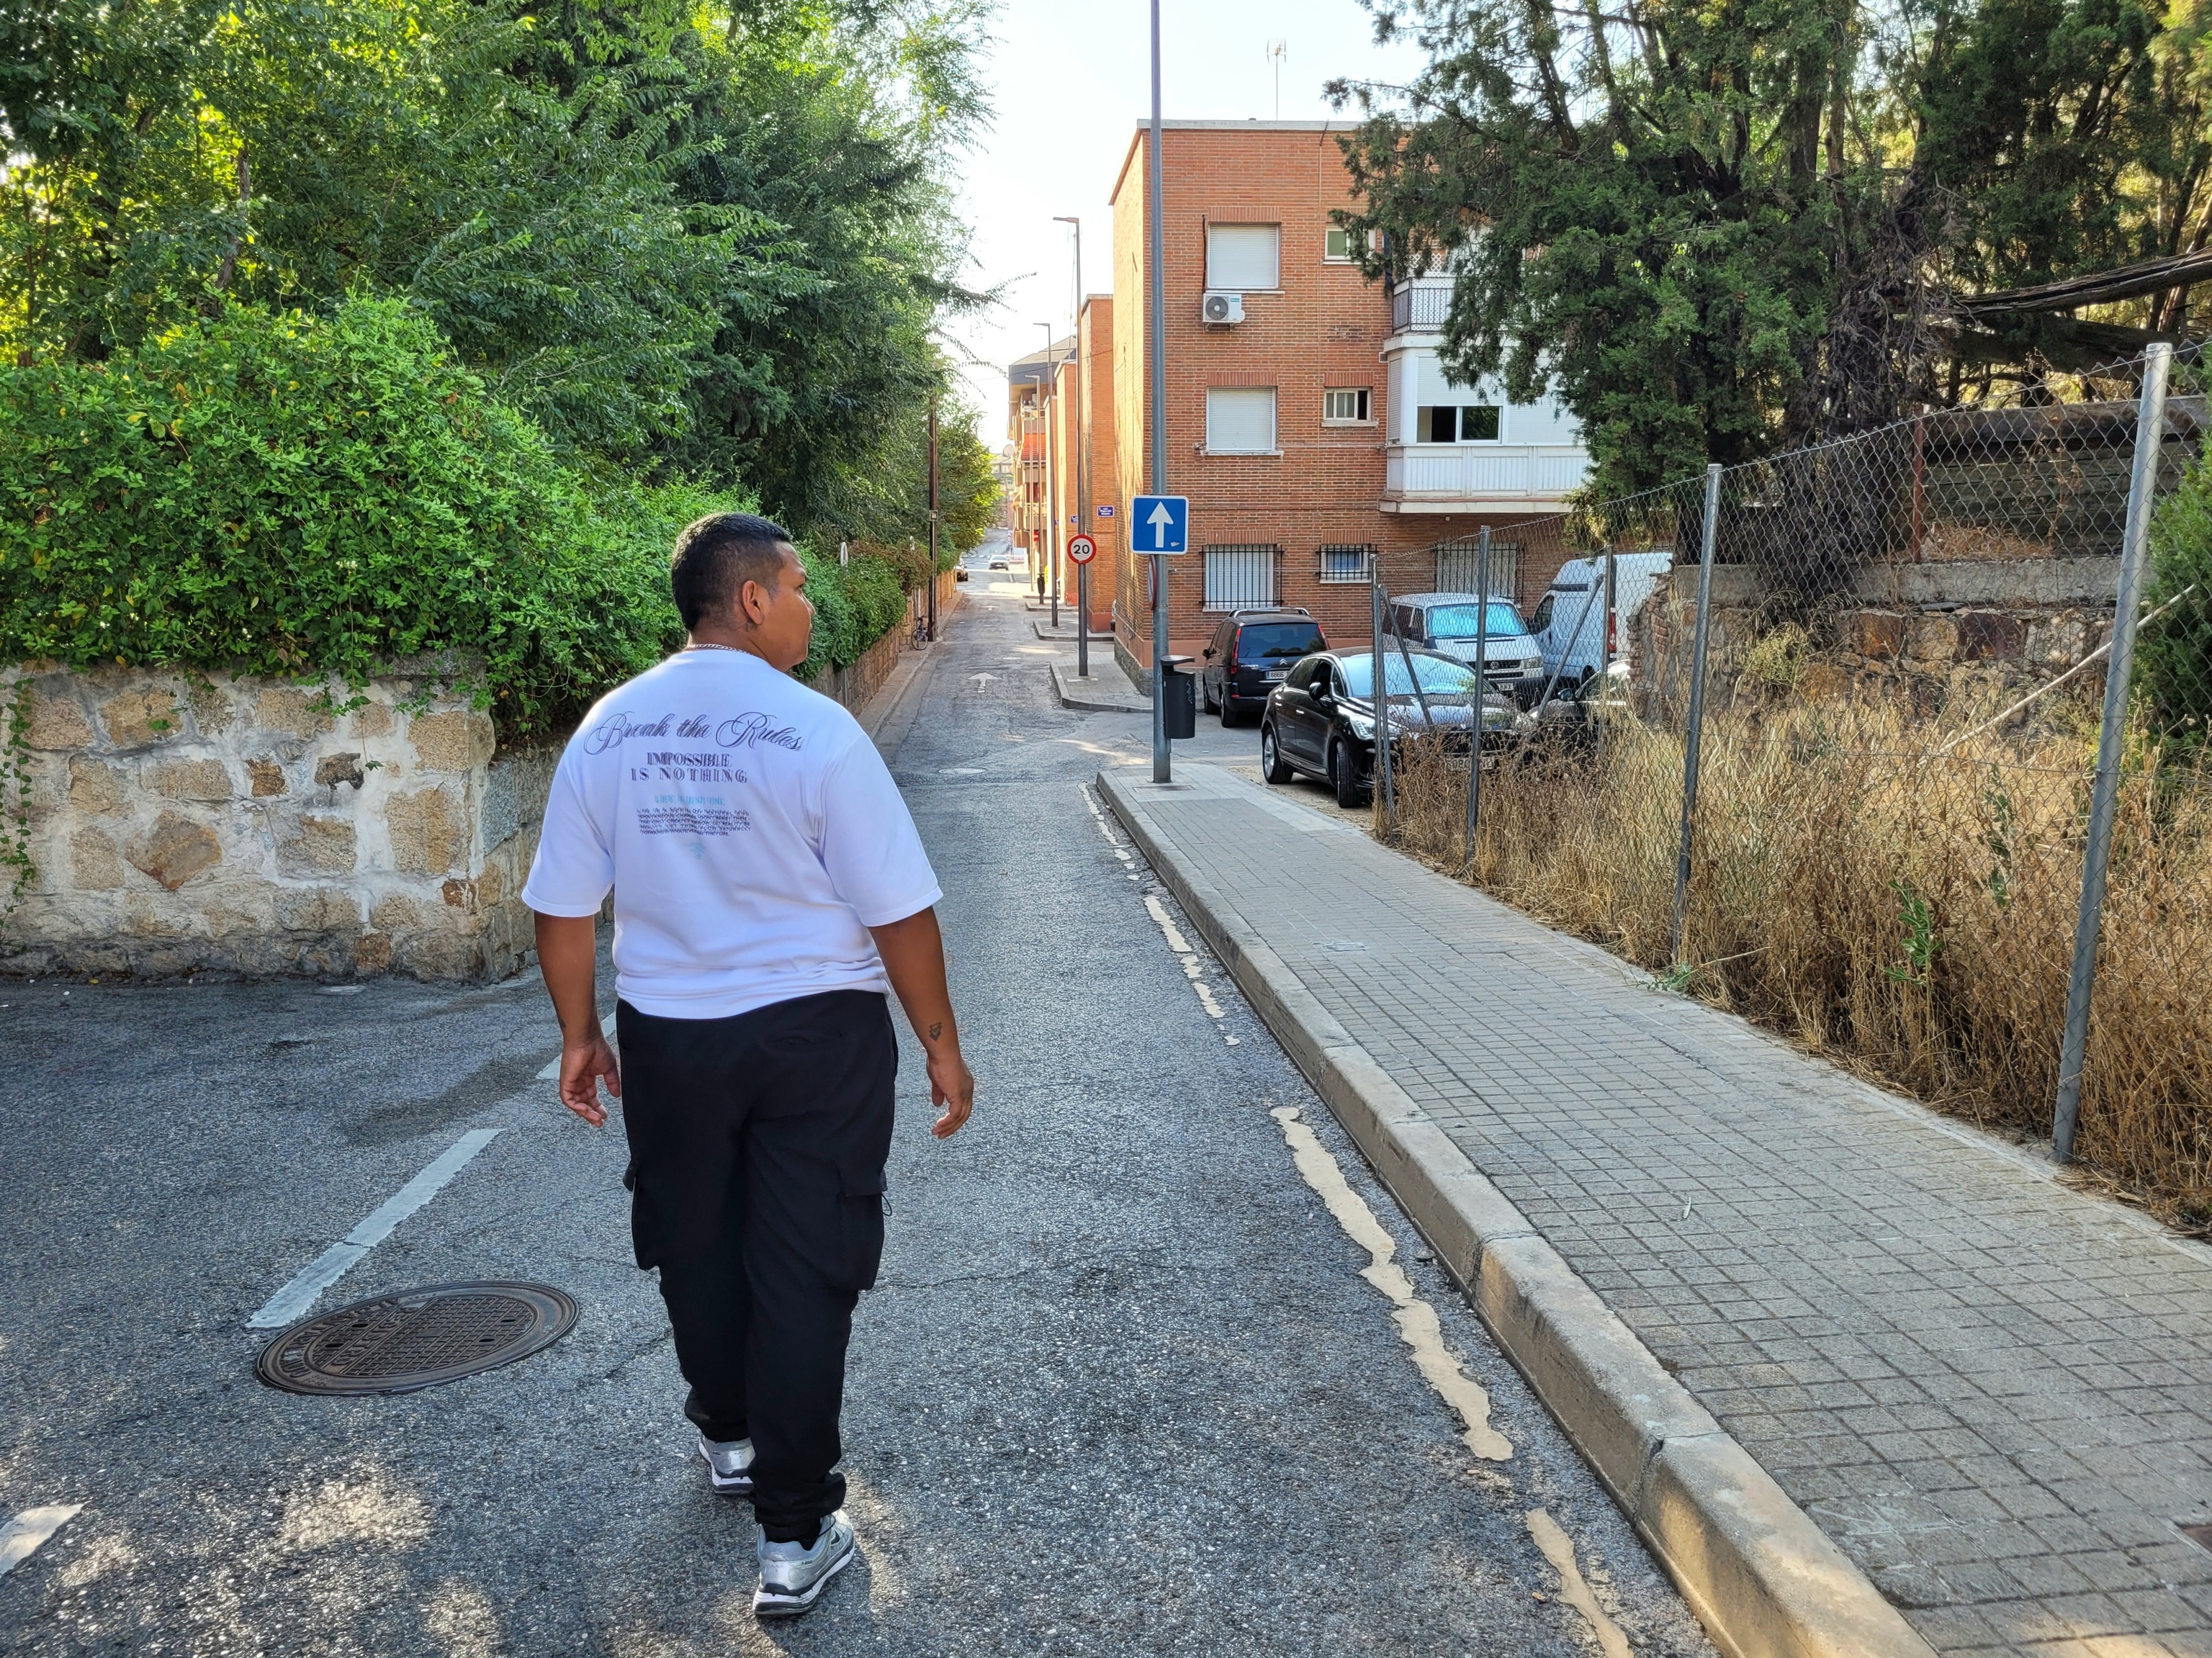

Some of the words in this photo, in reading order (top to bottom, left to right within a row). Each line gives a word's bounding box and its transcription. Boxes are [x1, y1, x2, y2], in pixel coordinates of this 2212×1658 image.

[1074, 544, 1090, 554] 20
[583, 711, 677, 755] Break
[677, 714, 713, 738] the
[715, 711, 806, 751] Rules
[647, 752, 732, 767] IMPOSSIBLE
[631, 768, 649, 781] IS
[659, 767, 747, 783] NOTHING
